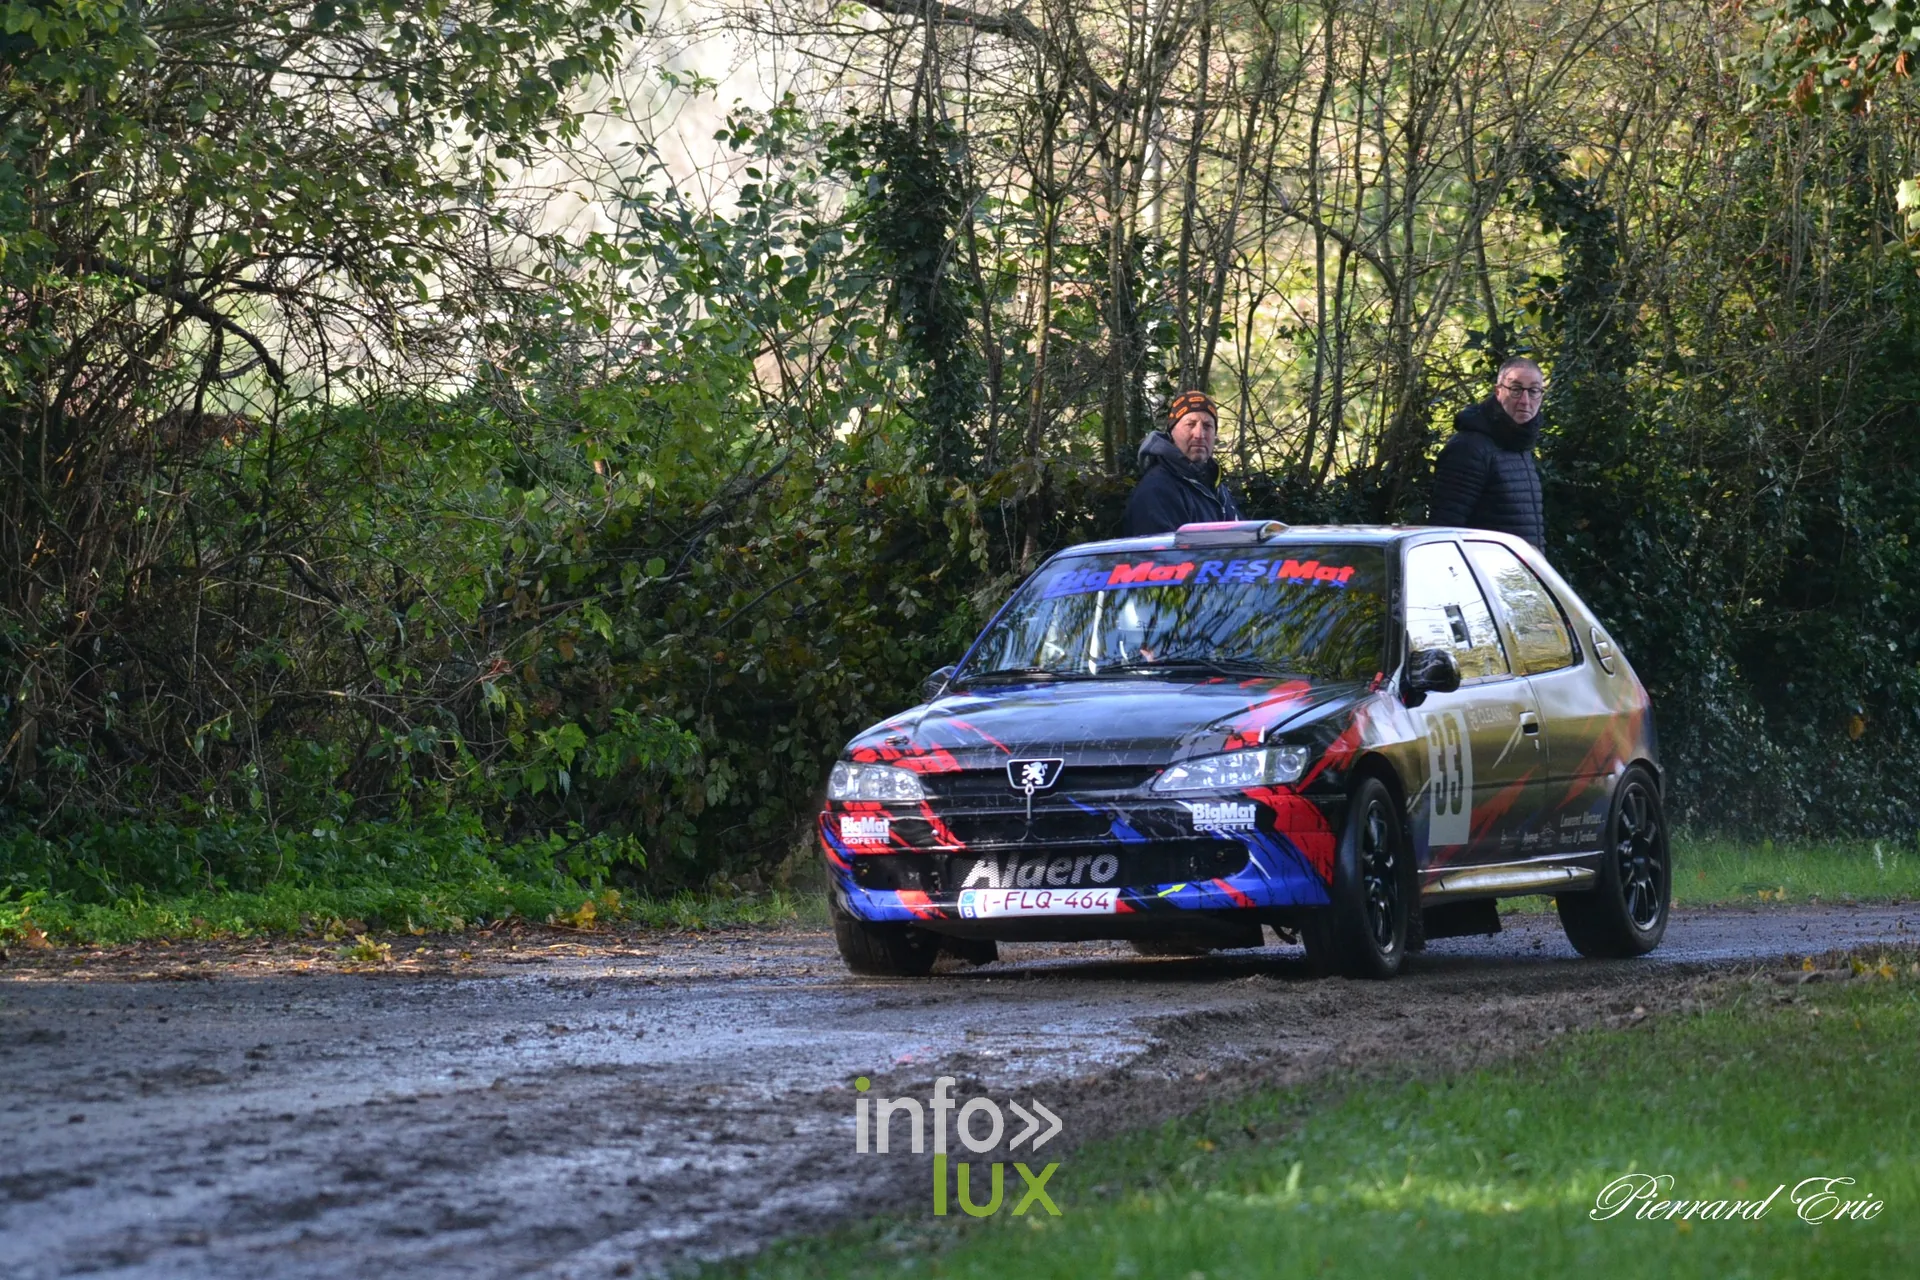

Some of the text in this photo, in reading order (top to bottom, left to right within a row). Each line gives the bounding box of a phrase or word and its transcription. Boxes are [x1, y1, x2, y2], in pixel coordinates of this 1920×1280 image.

[1050, 561, 1195, 594] BigMat
[1193, 802, 1256, 823] BigMat
[841, 816, 890, 837] BigMat
[1193, 823, 1255, 831] GOFETTE
[843, 837, 890, 845] GOFETTE
[964, 906, 973, 918] B
